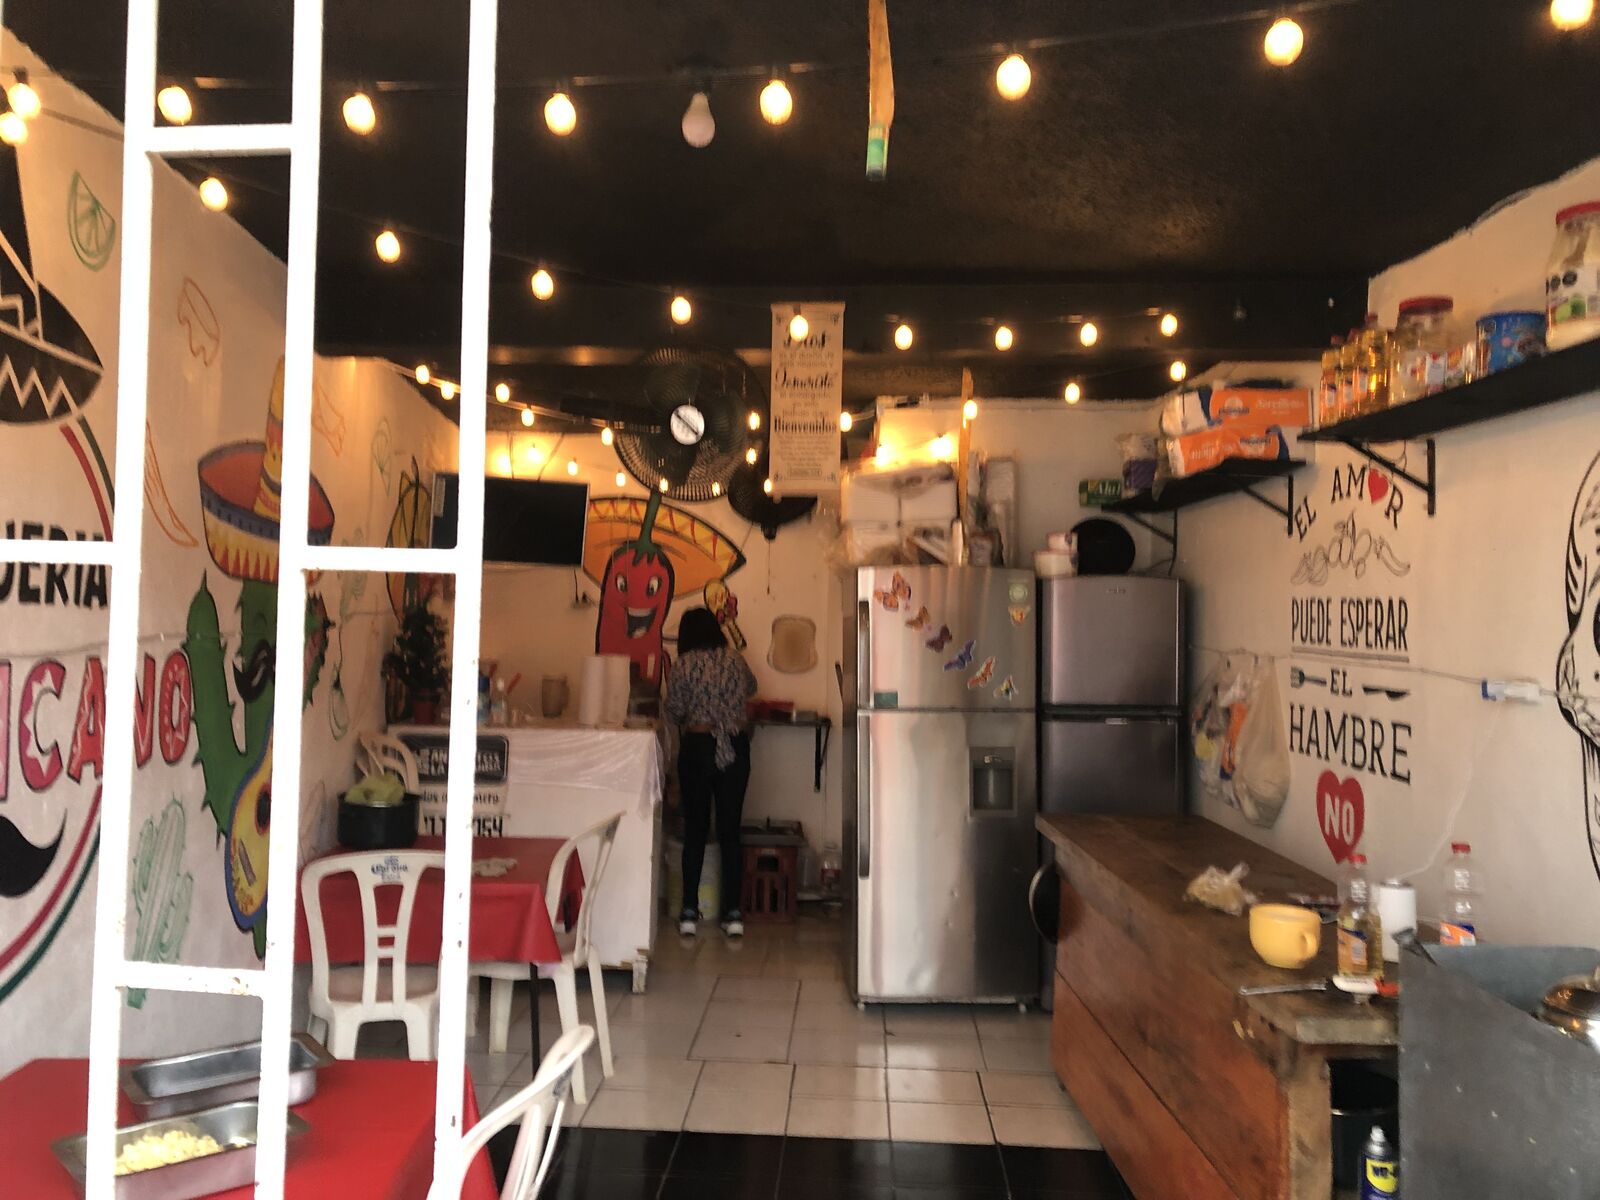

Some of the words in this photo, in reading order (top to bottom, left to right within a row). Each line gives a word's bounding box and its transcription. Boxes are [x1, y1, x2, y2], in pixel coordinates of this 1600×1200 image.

[1294, 495, 1317, 542] EL
[1290, 595, 1333, 647] PUEDE
[1339, 595, 1410, 652] ESPERAR
[1329, 667, 1353, 697] EL
[1288, 701, 1412, 786] HAMBRE
[1323, 791, 1356, 845] NO
